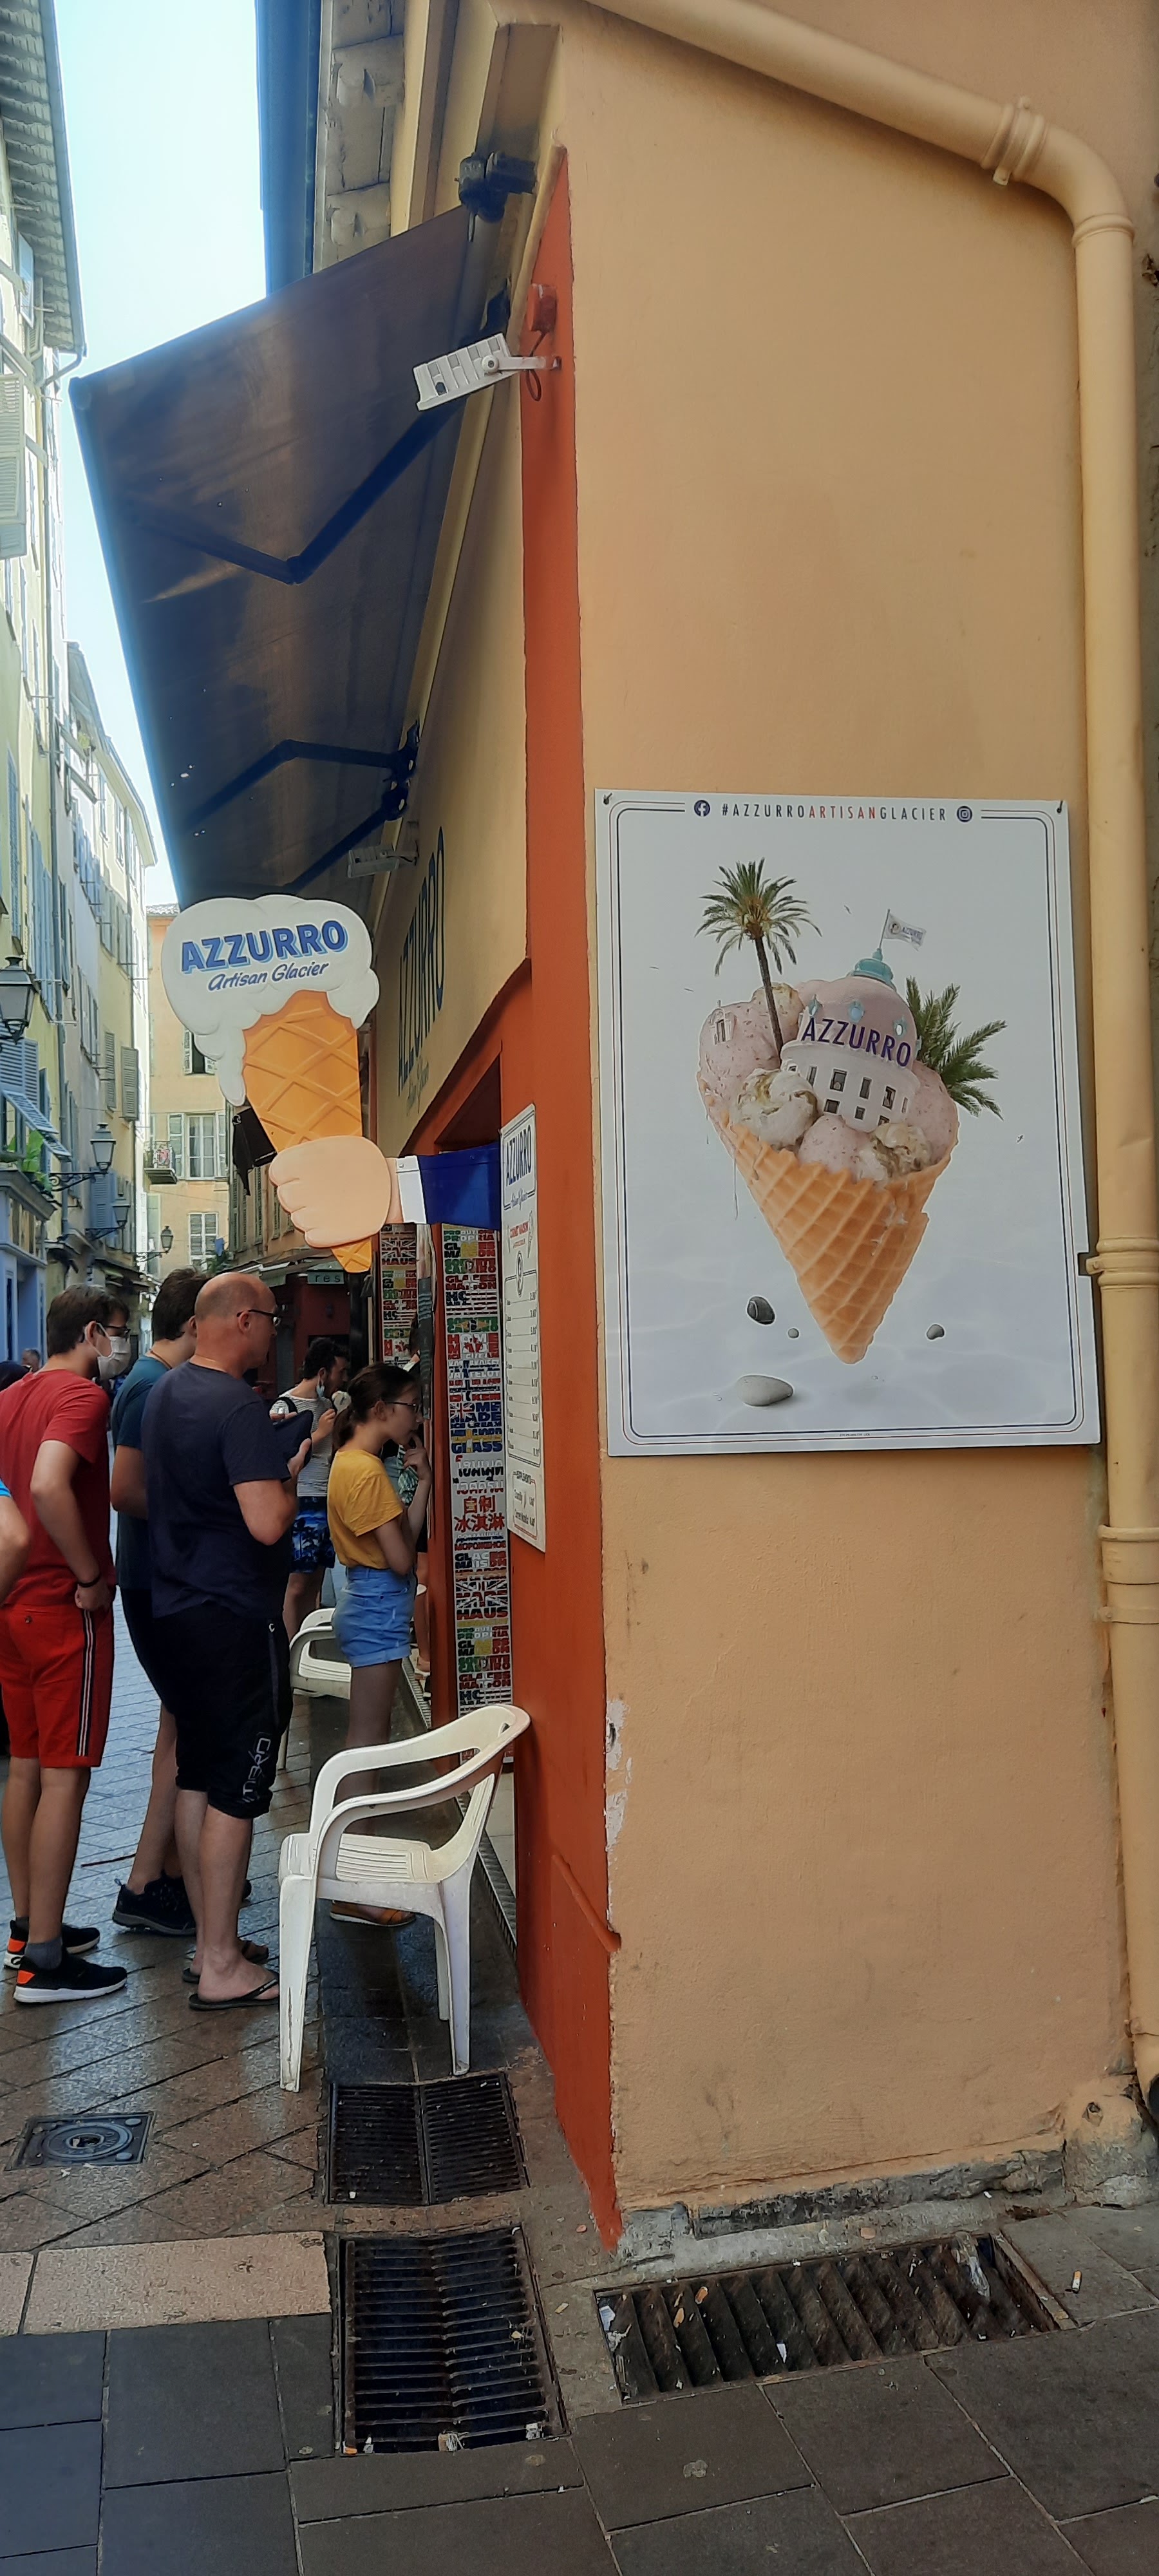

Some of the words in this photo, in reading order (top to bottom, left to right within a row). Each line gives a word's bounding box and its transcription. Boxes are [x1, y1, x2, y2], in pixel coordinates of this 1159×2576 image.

[722, 802, 947, 822] #AZZURROARTISANGLACIER
[181, 920, 349, 974] AZZURRO
[271, 962, 329, 983] Glacier
[800, 1016, 912, 1068] AZZURRO
[506, 1124, 532, 1187] AZZURRO
[457, 1606, 509, 1620] HAUS
